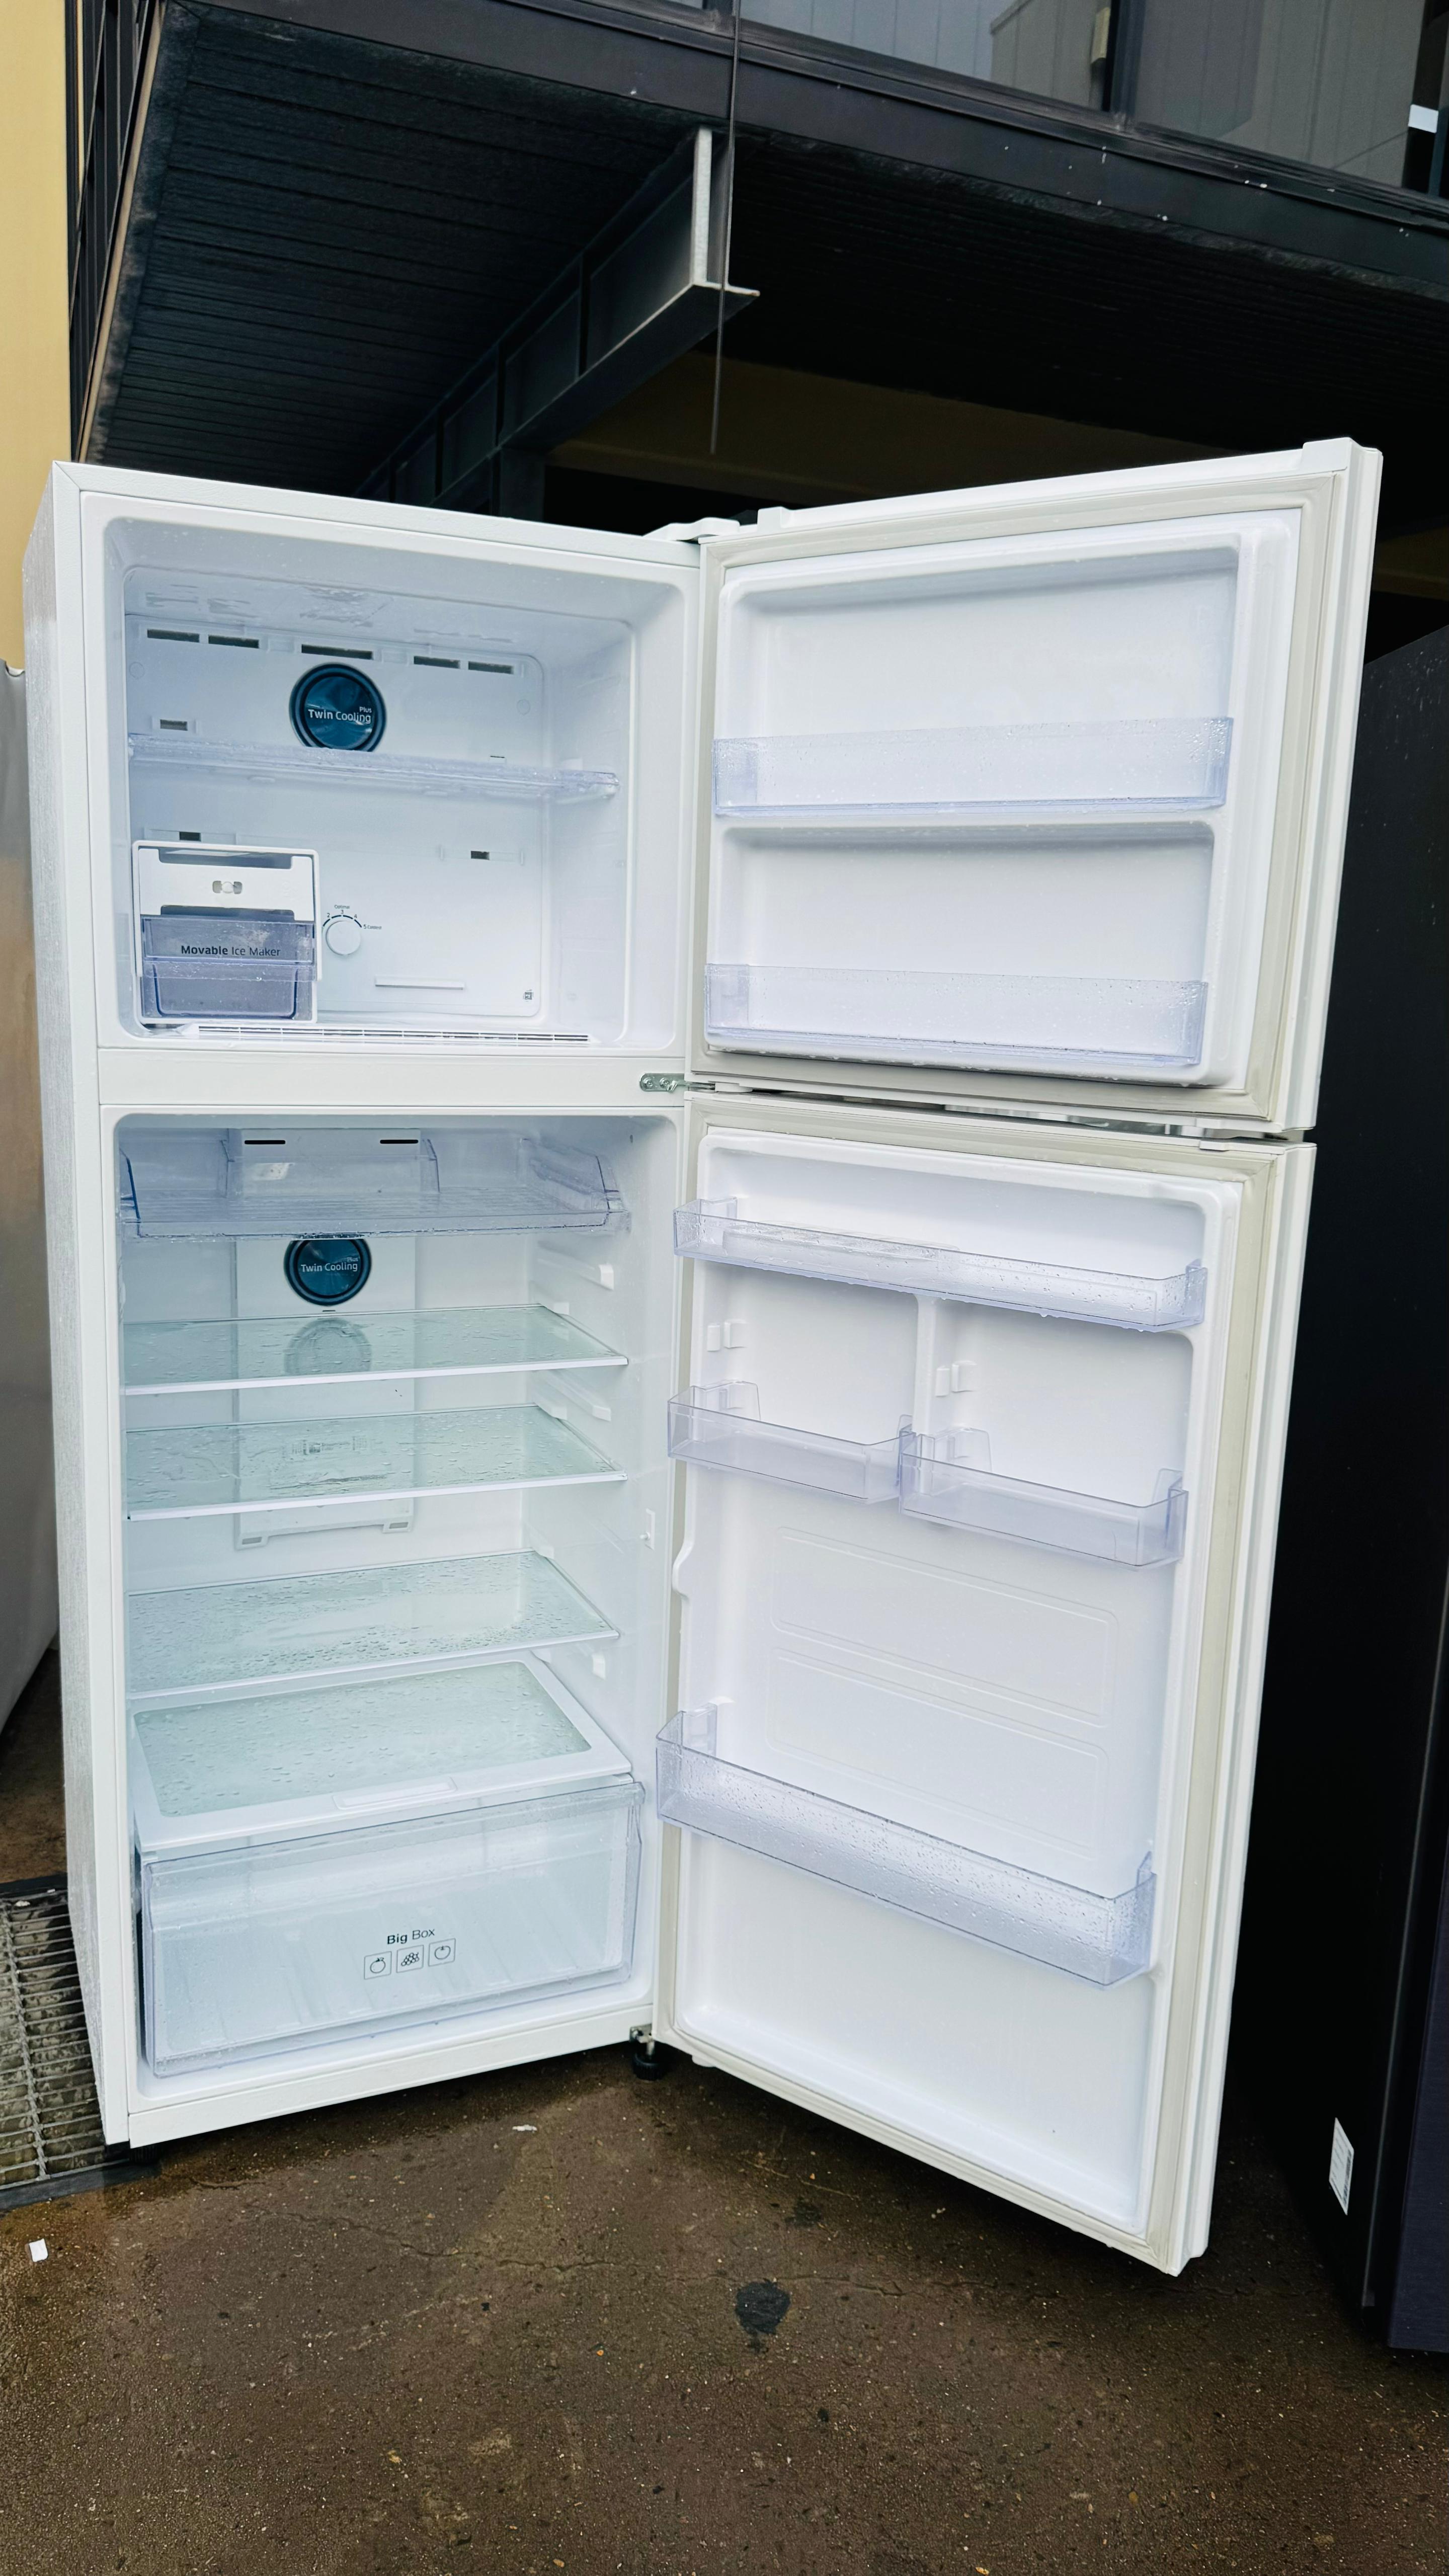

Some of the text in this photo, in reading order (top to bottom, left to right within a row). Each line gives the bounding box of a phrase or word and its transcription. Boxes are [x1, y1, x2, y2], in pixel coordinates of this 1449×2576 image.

[308, 709, 371, 724] Twin Cooling
[181, 945, 281, 956] Movable Ice Maker
[301, 1262, 357, 1272] Twin Cooling
[387, 1929, 435, 1944] Big Box
